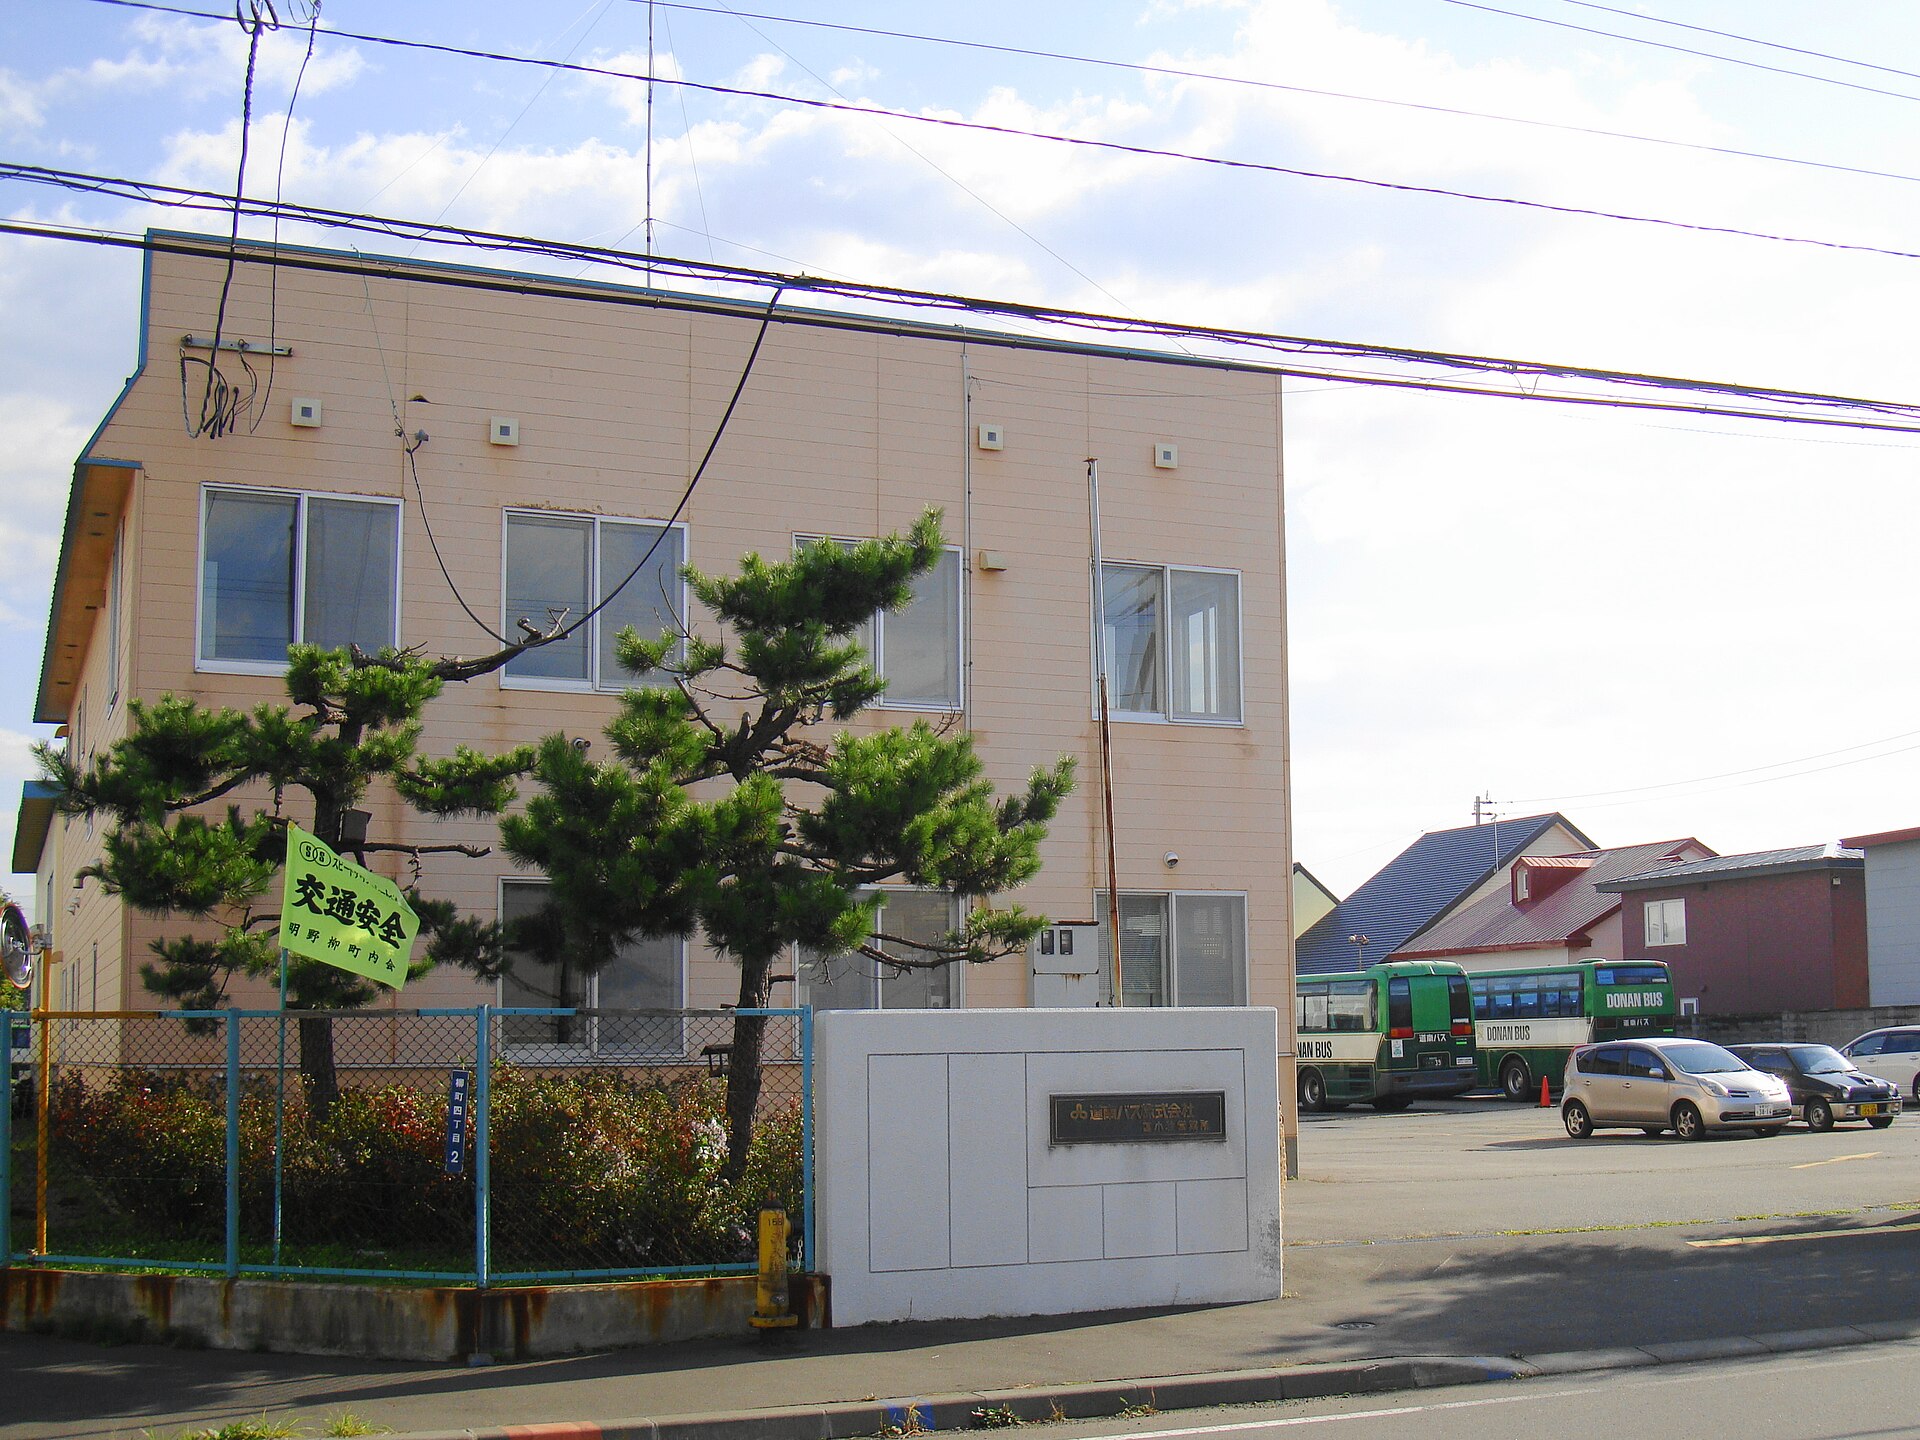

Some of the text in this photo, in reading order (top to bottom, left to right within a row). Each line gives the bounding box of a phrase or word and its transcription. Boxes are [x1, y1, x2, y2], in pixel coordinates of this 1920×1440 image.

[291, 873, 407, 949] 交通安全
[288, 922, 396, 972] 明野柳町内会
[1606, 992, 1663, 1008] DONAN BUS
[1419, 1033, 1447, 1043] 道南バス
[1487, 1025, 1531, 1041] DONAN BUS
[1315, 1040, 1332, 1058] BUS
[450, 1078, 466, 1164] 柳町四丁目 2
